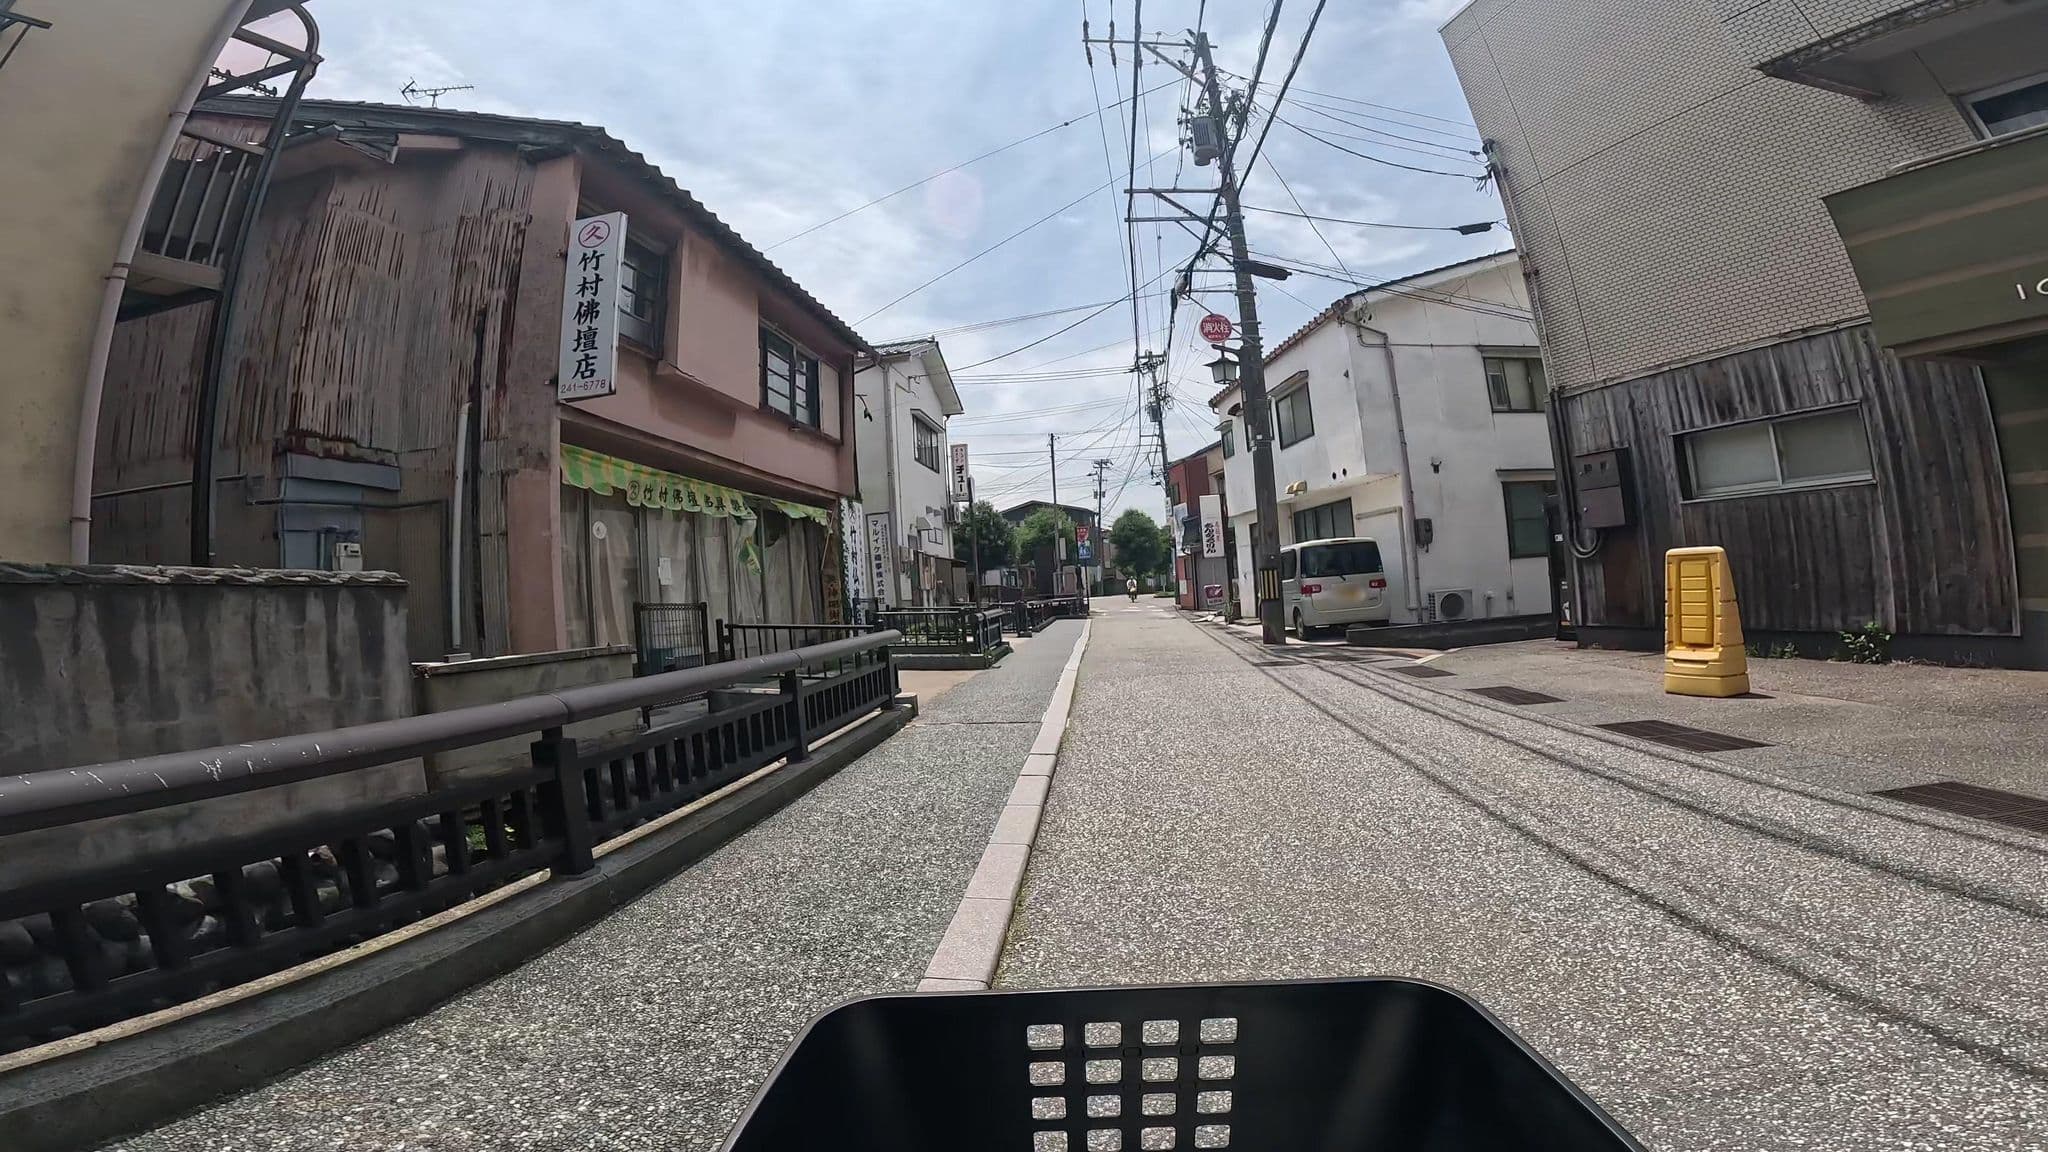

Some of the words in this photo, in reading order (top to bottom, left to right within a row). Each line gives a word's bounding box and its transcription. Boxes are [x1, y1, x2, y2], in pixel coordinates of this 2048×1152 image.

[581, 222, 607, 245] 久
[572, 249, 605, 381] 竹村佛壇店
[1203, 321, 1230, 334] 消火栓
[560, 379, 607, 394] 241-6778
